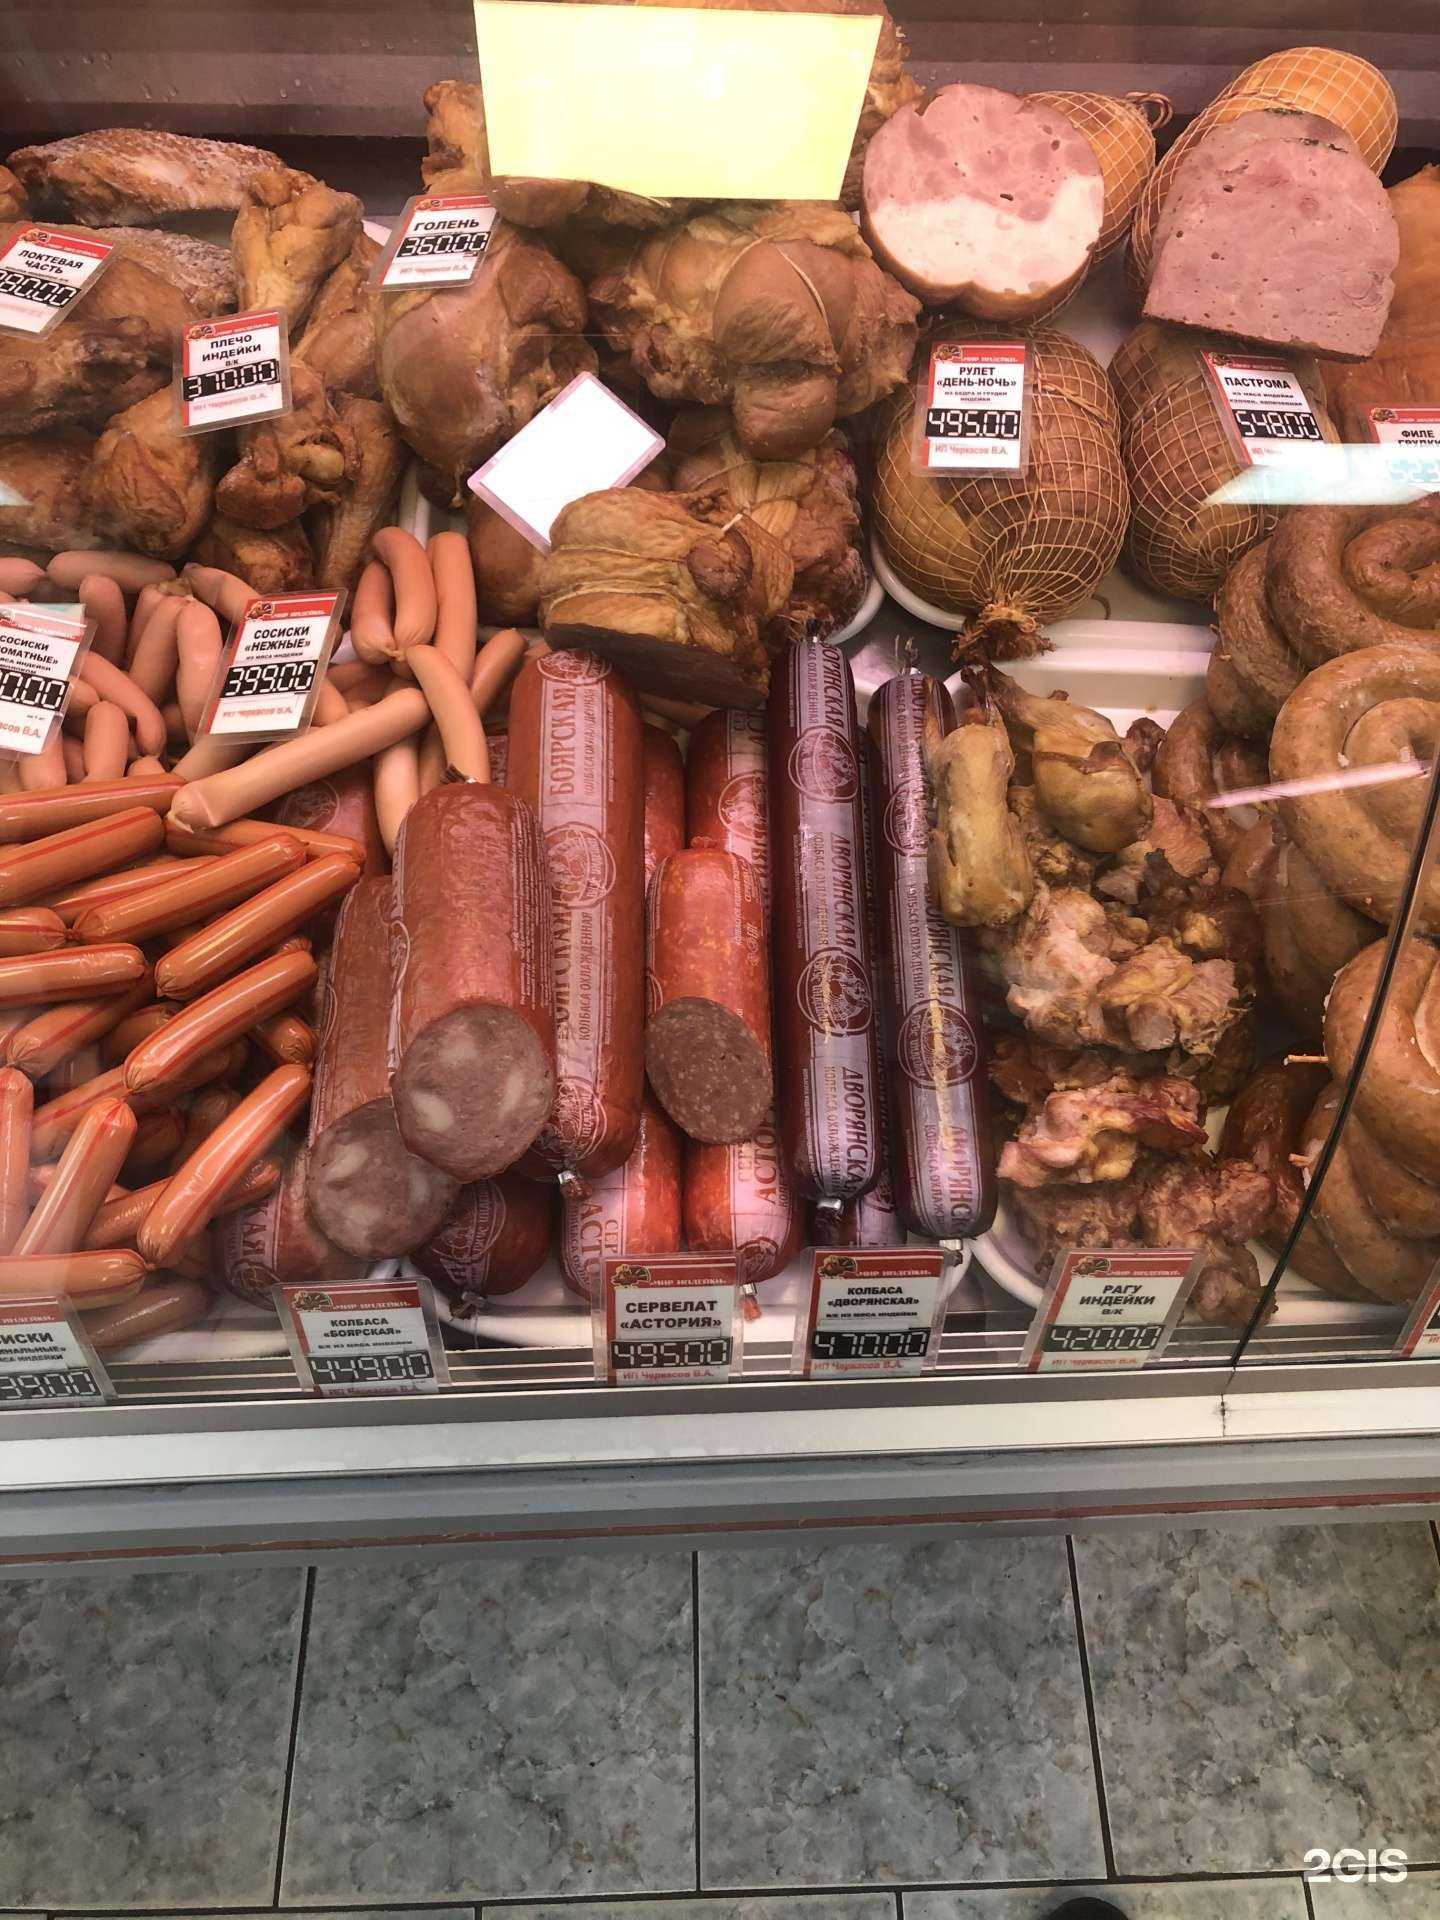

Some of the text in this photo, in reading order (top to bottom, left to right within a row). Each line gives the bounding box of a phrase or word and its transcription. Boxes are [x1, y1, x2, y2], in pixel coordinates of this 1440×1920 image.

[414, 219, 480, 231] ГОЛЕНЬ
[18, 250, 84, 269] ЛОКТЕВАЯ
[25, 260, 63, 274] ЧАСТЬ
[210, 335, 252, 349] ПЛЕЧО
[202, 344, 261, 362] ИНДЕЙКИ
[959, 367, 996, 376] РУЛЕТ
[188, 361, 275, 398] 370.00
[937, 378, 1017, 388] «ДЕНЬ-НОЧЬ»
[1224, 377, 1292, 389] ПАСТРОМА
[929, 410, 1018, 437] 495.00
[1236, 410, 1320, 438] 548.00
[1402, 430, 1435, 438] ФИЛЕ
[254, 626, 310, 639] СОСИСКИ
[245, 638, 310, 652] «НЕЖНЫЕ»
[0, 646, 58, 665] ОМАТНЫЕ»
[225, 662, 315, 696] 399.00
[550, 687, 577, 796] БОЯРСКАЯ
[831, 832, 856, 949] ДВОРЯНСКАЯ
[909, 926, 924, 999] ОХЛАЖДЕННАЯ
[579, 912, 594, 1040] КОЛБАСА ОХЛАЖДЕННАЯ
[848, 1287, 903, 1295] КОЛБАСА
[1102, 1285, 1143, 1294] РАГУ
[625, 1300, 718, 1313] СЕРВЕЛАТ
[828, 1297, 920, 1307] «ДВОРЯНСКАЯ»
[1079, 1294, 1156, 1305] ИНДЕЙКИ
[331, 1317, 389, 1327] КОЛБАСА
[620, 1317, 722, 1329] «АСТОРИЯ»
[323, 1327, 402, 1338] «БОЯРСКАЯ»
[1051, 1327, 1163, 1350] 420.00
[815, 1331, 927, 1356] 470.00
[614, 1340, 727, 1367] 495.00
[312, 1353, 429, 1380] 449.00
